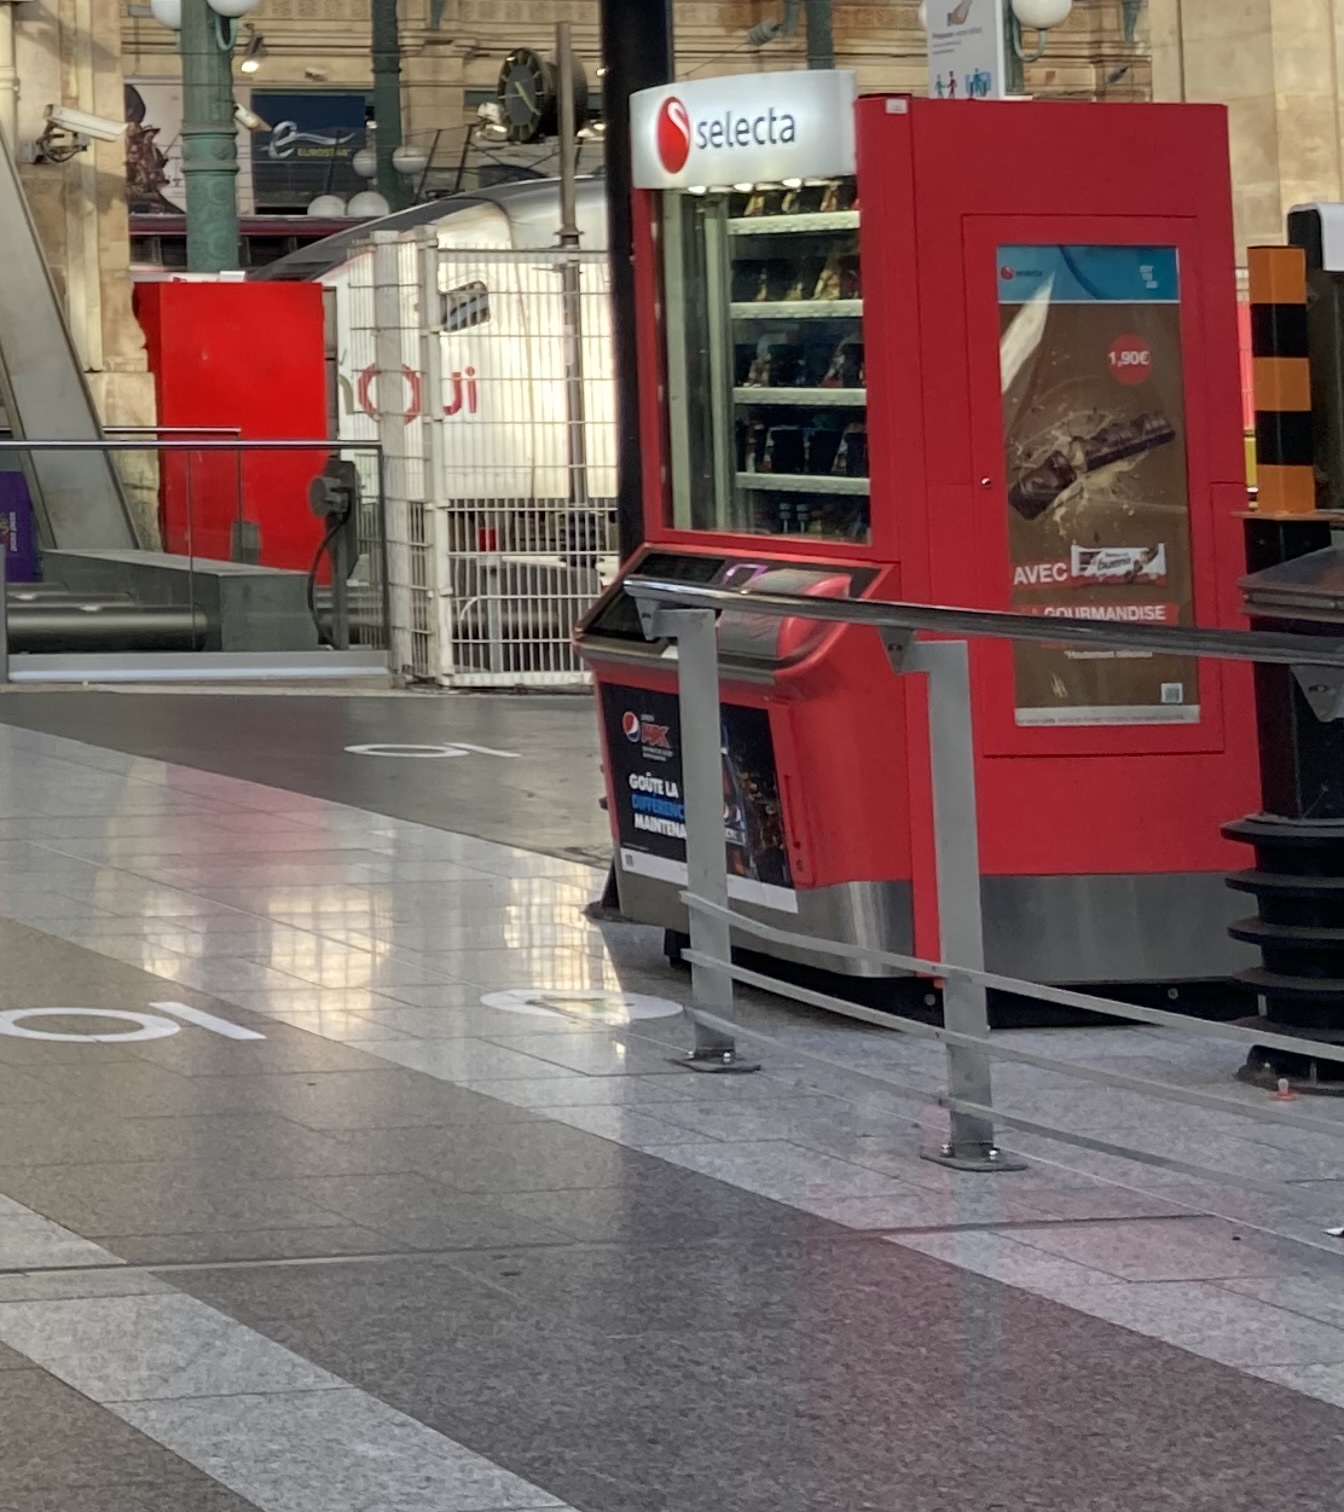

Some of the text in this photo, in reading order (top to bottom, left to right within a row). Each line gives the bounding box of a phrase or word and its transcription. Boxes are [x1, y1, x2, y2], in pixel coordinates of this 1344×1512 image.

[696, 106, 795, 150] selecta
[297, 148, 349, 157] EUROSTAR
[1107, 350, 1150, 367] 1,90€
[1013, 562, 1068, 586] AVEC
[1044, 604, 1166, 621] GOURMANDISE
[628, 771, 680, 799] GOÛTE LA
[633, 812, 688, 840] MAINTENA
